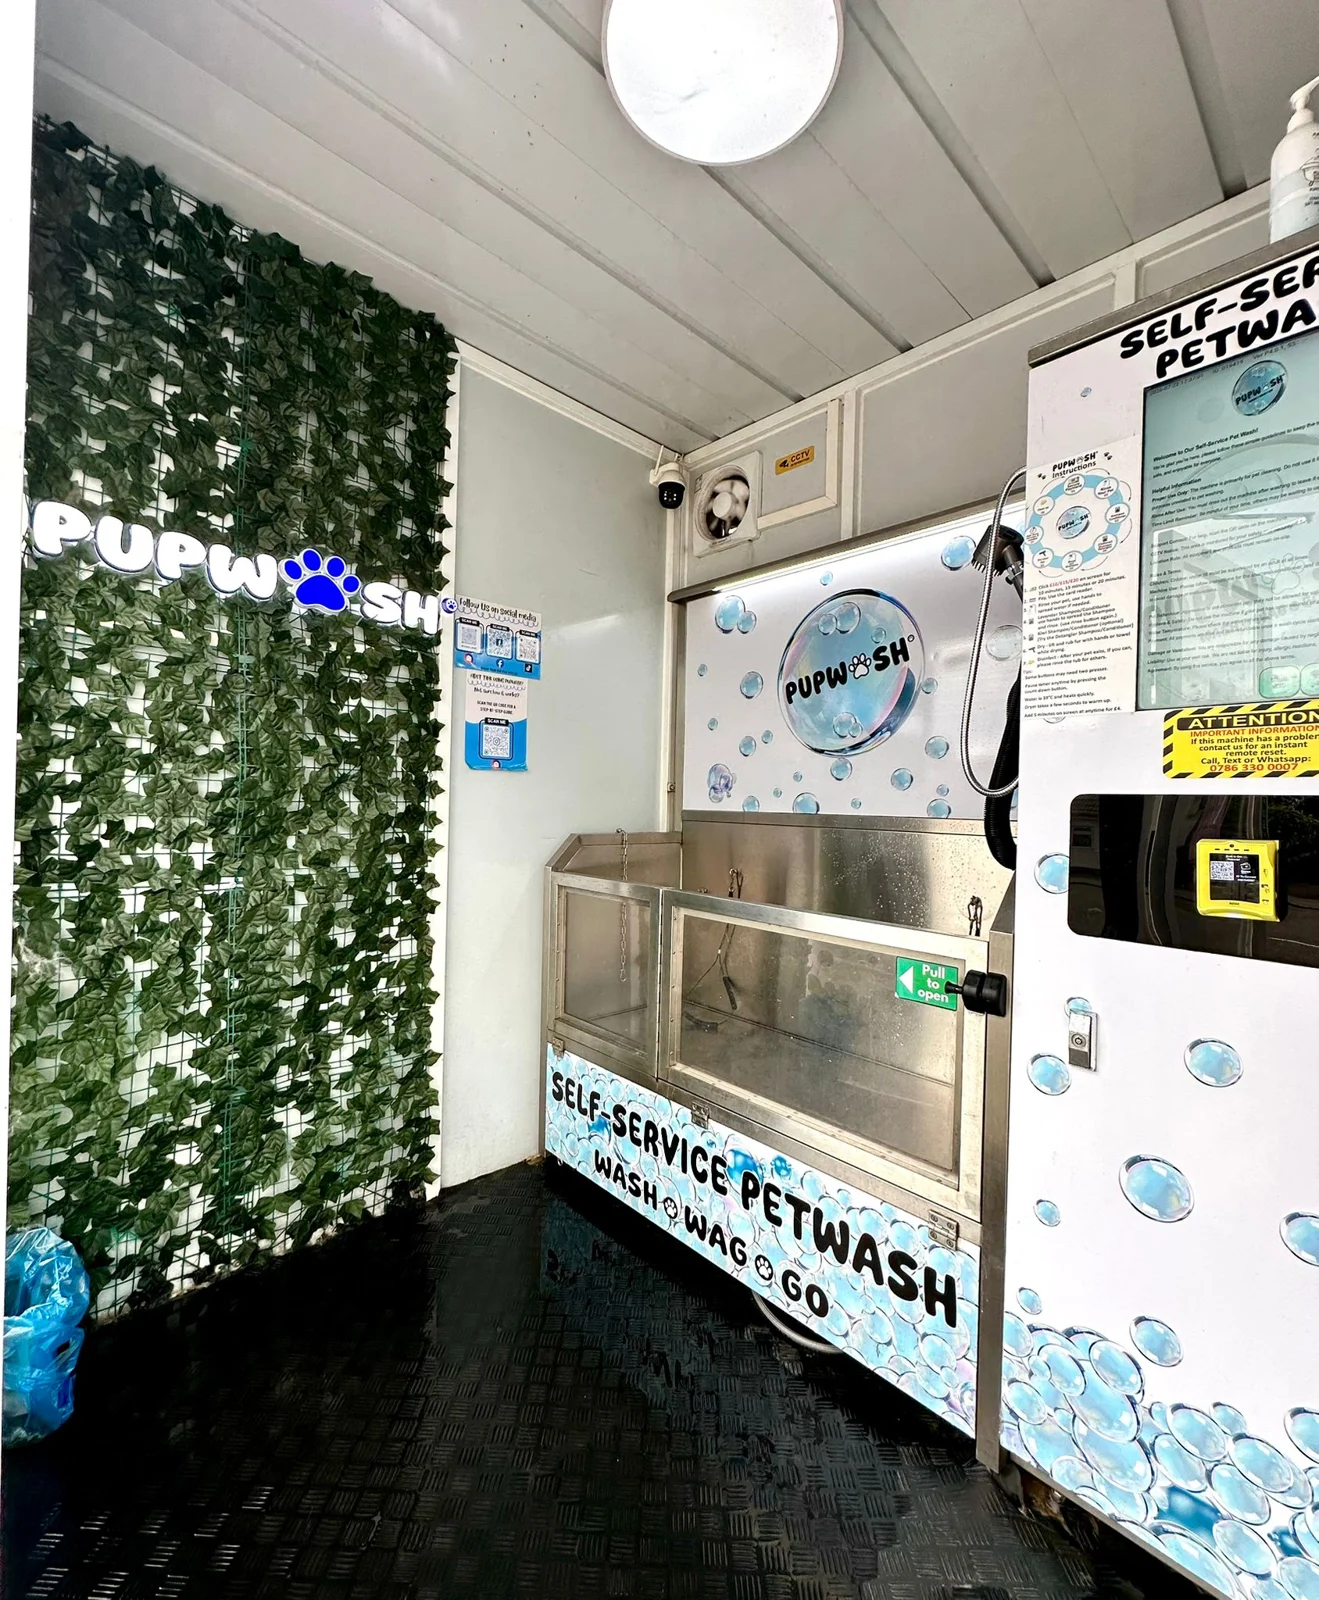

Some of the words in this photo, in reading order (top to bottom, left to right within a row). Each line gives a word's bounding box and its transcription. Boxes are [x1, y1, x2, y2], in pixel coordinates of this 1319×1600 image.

[1156, 298, 1316, 379] PETWA
[790, 450, 810, 462] CCTV
[1052, 460, 1096, 478] Instructions
[1188, 711, 1319, 729] ATTENTION
[1190, 729, 1244, 738] IMPORTANT
[1248, 724, 1319, 735] INFORMATION
[1217, 736, 1254, 744] machine
[1246, 742, 1258, 750] for
[1257, 756, 1311, 764] Whatsapp:
[1210, 764, 1238, 772] 0786
[922, 964, 946, 979] Pull
[926, 977, 940, 990] to
[918, 989, 949, 1003] open
[552, 1071, 728, 1196] SELF-SERVICE
[741, 1171, 957, 1328] PETWASH
[594, 1150, 657, 1210] WASH
[684, 1204, 748, 1266] WAG
[781, 1269, 828, 1318] GO
